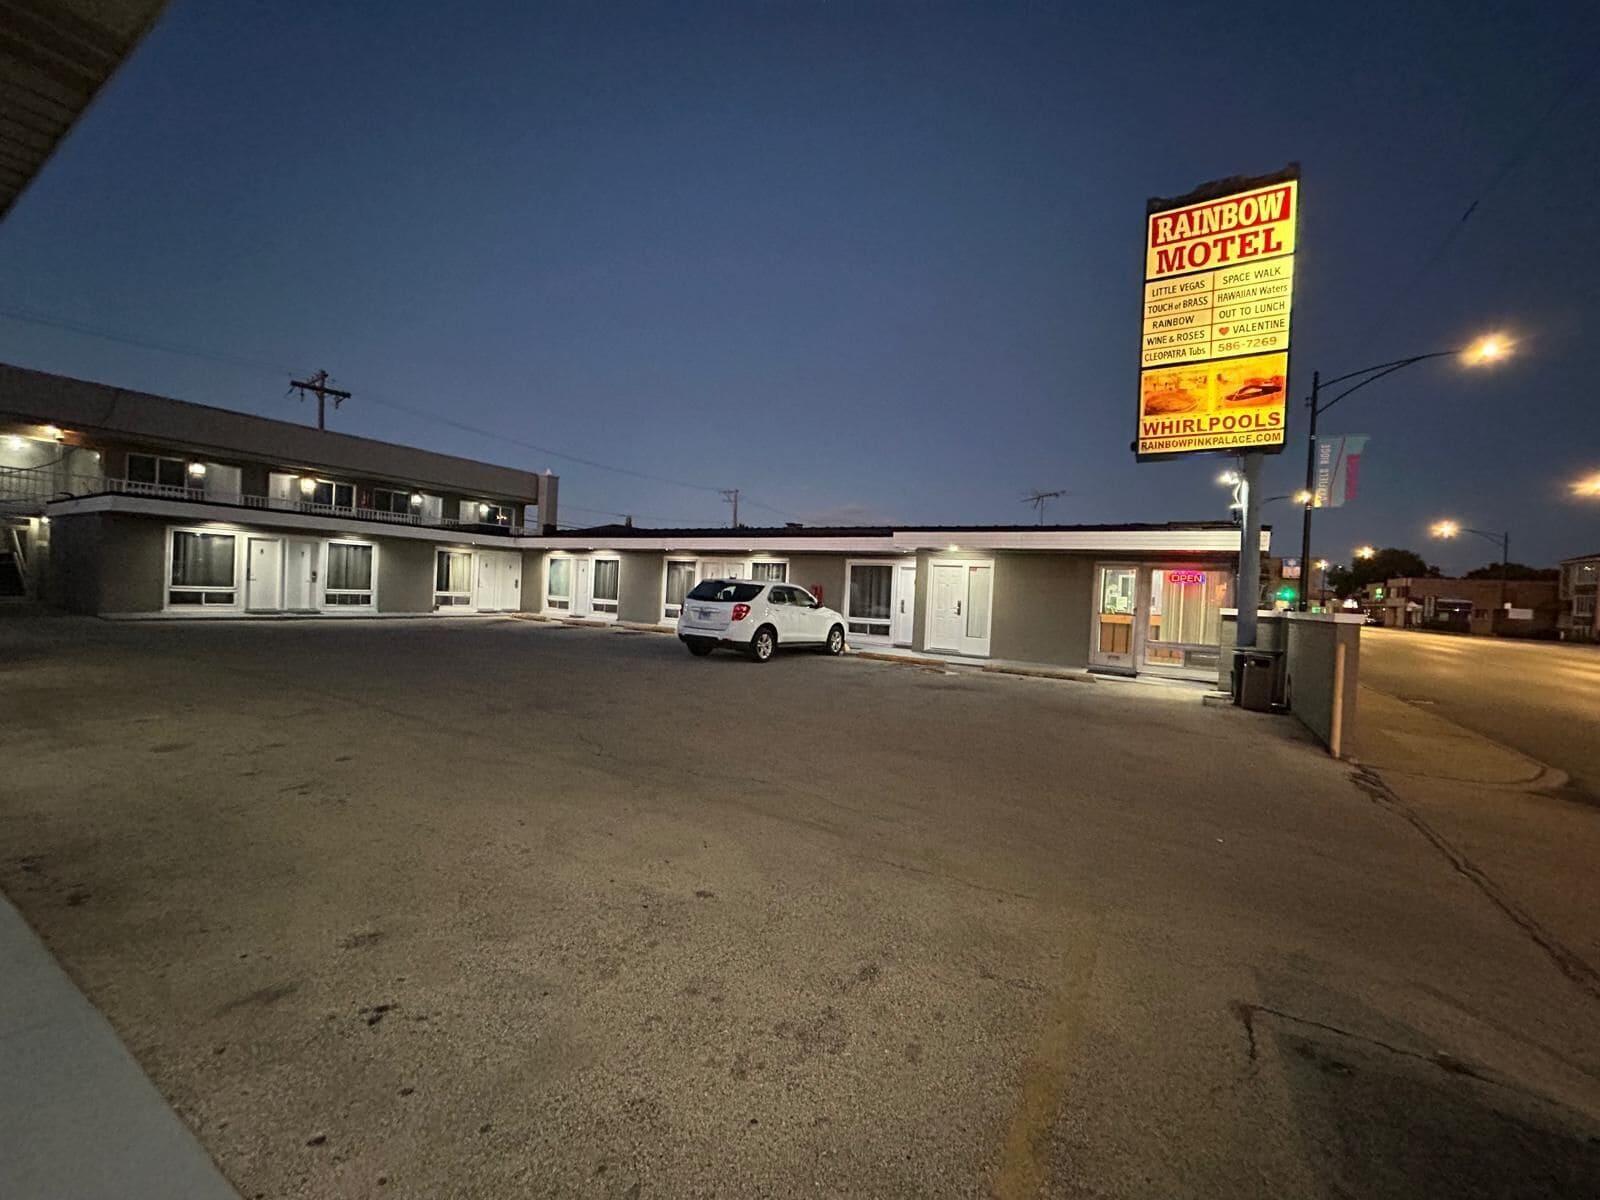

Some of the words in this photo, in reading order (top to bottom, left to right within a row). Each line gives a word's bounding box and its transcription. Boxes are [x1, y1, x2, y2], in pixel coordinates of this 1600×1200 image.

[1156, 190, 1285, 243] RAINBOW
[1156, 227, 1282, 274] MOTEL
[1222, 272, 1251, 285] SPACE
[1254, 266, 1281, 279] WALK
[1151, 284, 1177, 297] LITTLE
[1179, 280, 1206, 292] VEGAS
[1217, 290, 1258, 303] HAWAIIAN
[1259, 284, 1288, 296] Waters
[1148, 303, 1174, 314] TOUCH
[1182, 296, 1209, 308] BRASS
[1218, 309, 1237, 319] OUT
[1239, 306, 1251, 316] TO
[1254, 301, 1285, 314] LUNCH
[1152, 315, 1195, 329] RAINBOW
[1232, 319, 1286, 334] VALENTINE
[1146, 335, 1168, 346] WINE
[1168, 335, 1175, 344] &
[1176, 330, 1206, 342] ROSES
[1218, 336, 1277, 352] 586-7269
[1144, 348, 1187, 362] CLEOPATRA
[1189, 345, 1206, 357] Tubs
[1143, 412, 1281, 436] WHIRLPOOLS
[1140, 432, 1281, 451] RAINBOWPINKPALACE.COM
[1171, 573, 1202, 583] OPEN
